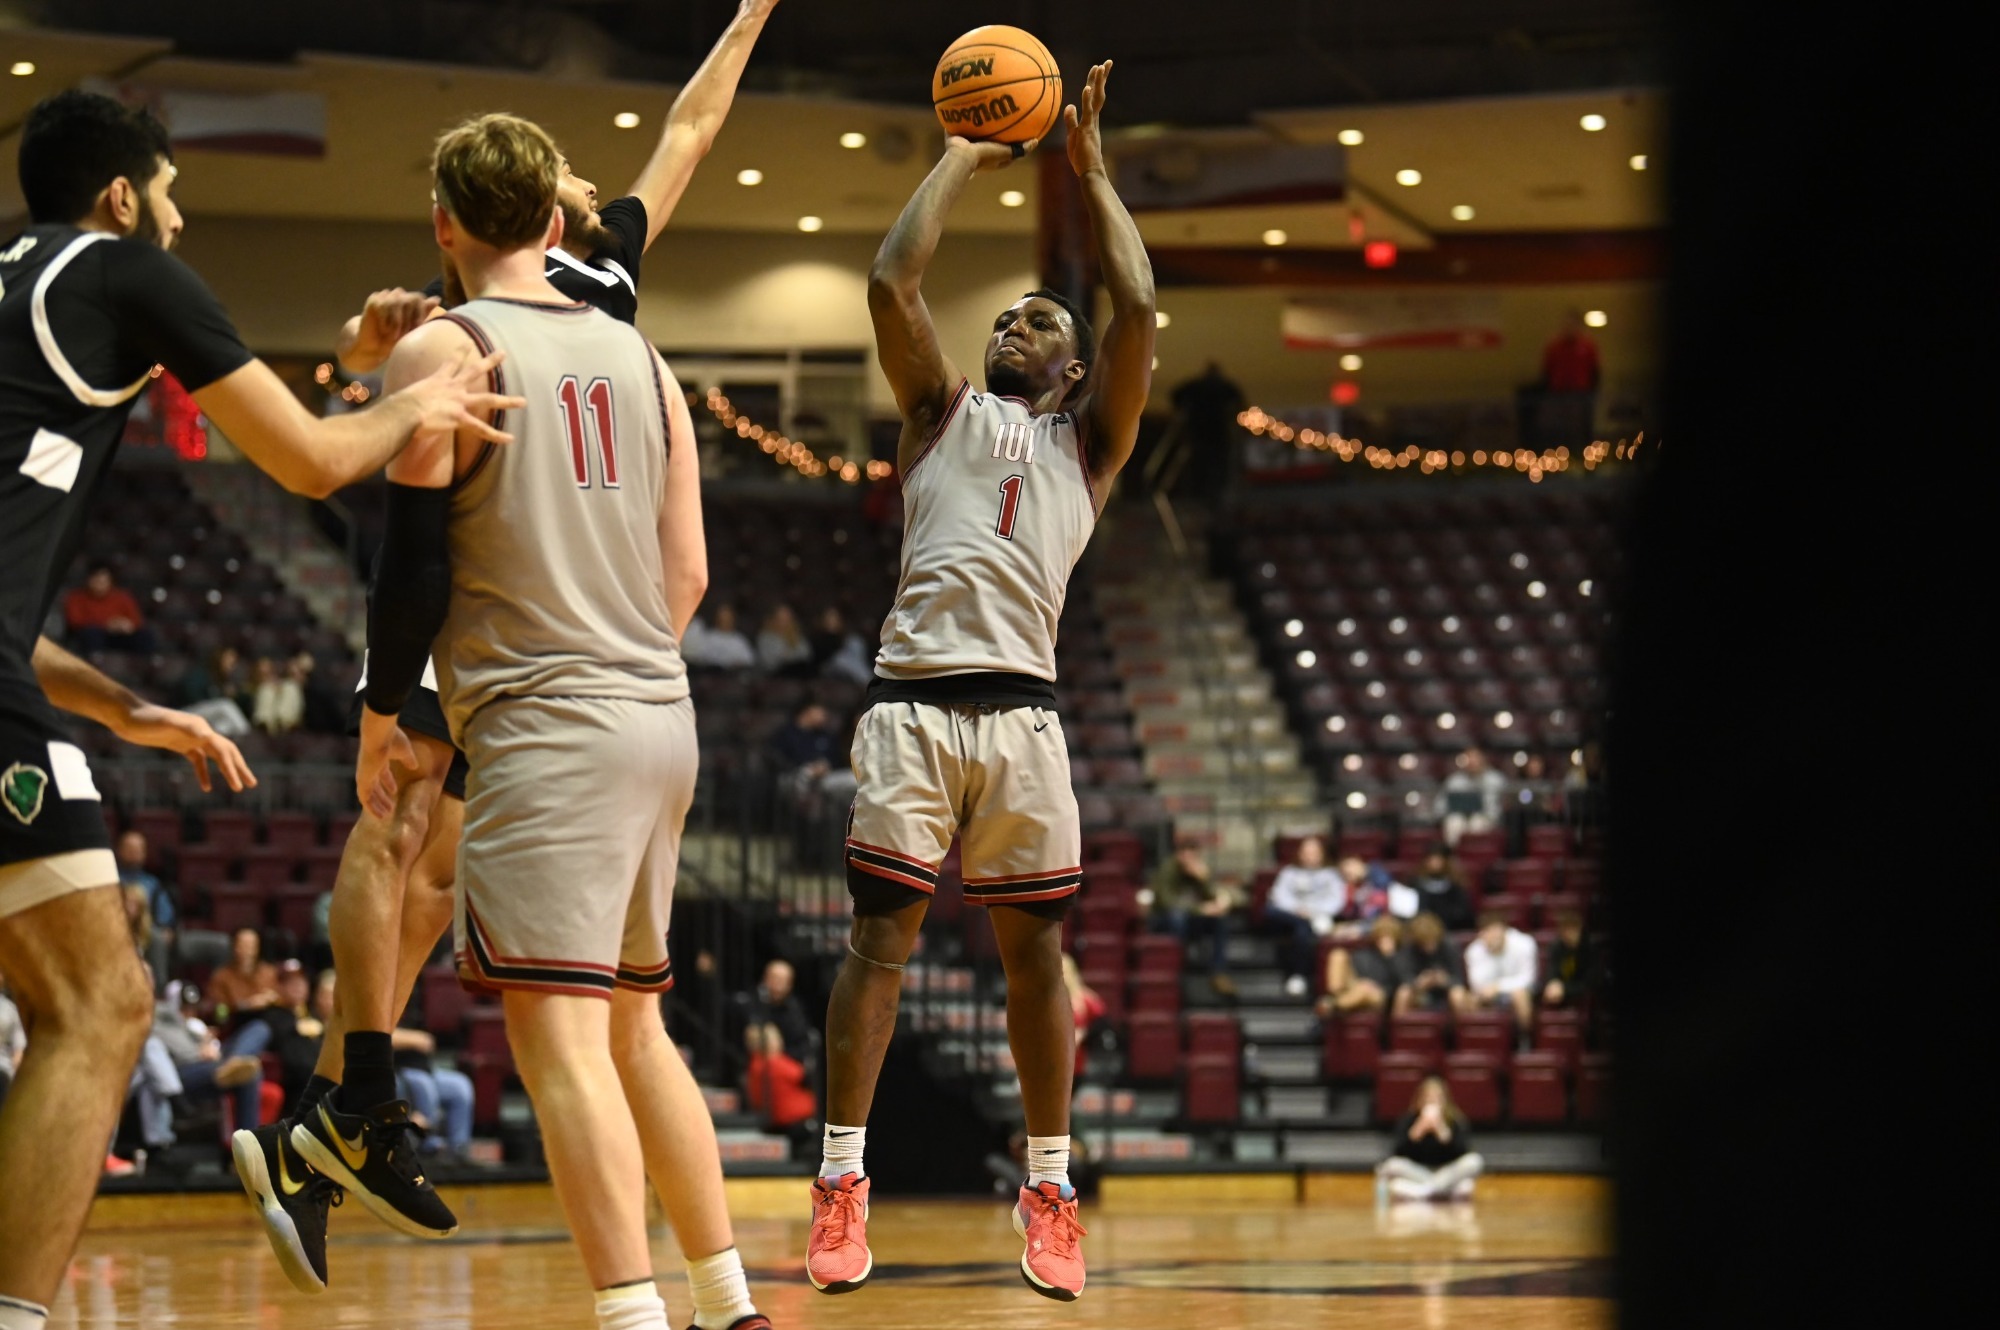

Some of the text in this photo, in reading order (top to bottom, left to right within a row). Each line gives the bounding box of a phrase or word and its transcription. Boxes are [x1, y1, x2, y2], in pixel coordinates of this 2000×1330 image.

[941, 58, 994, 88] NCAA
[941, 94, 1020, 128] Wilson
[557, 374, 620, 489] 11
[995, 474, 1024, 541] 1
